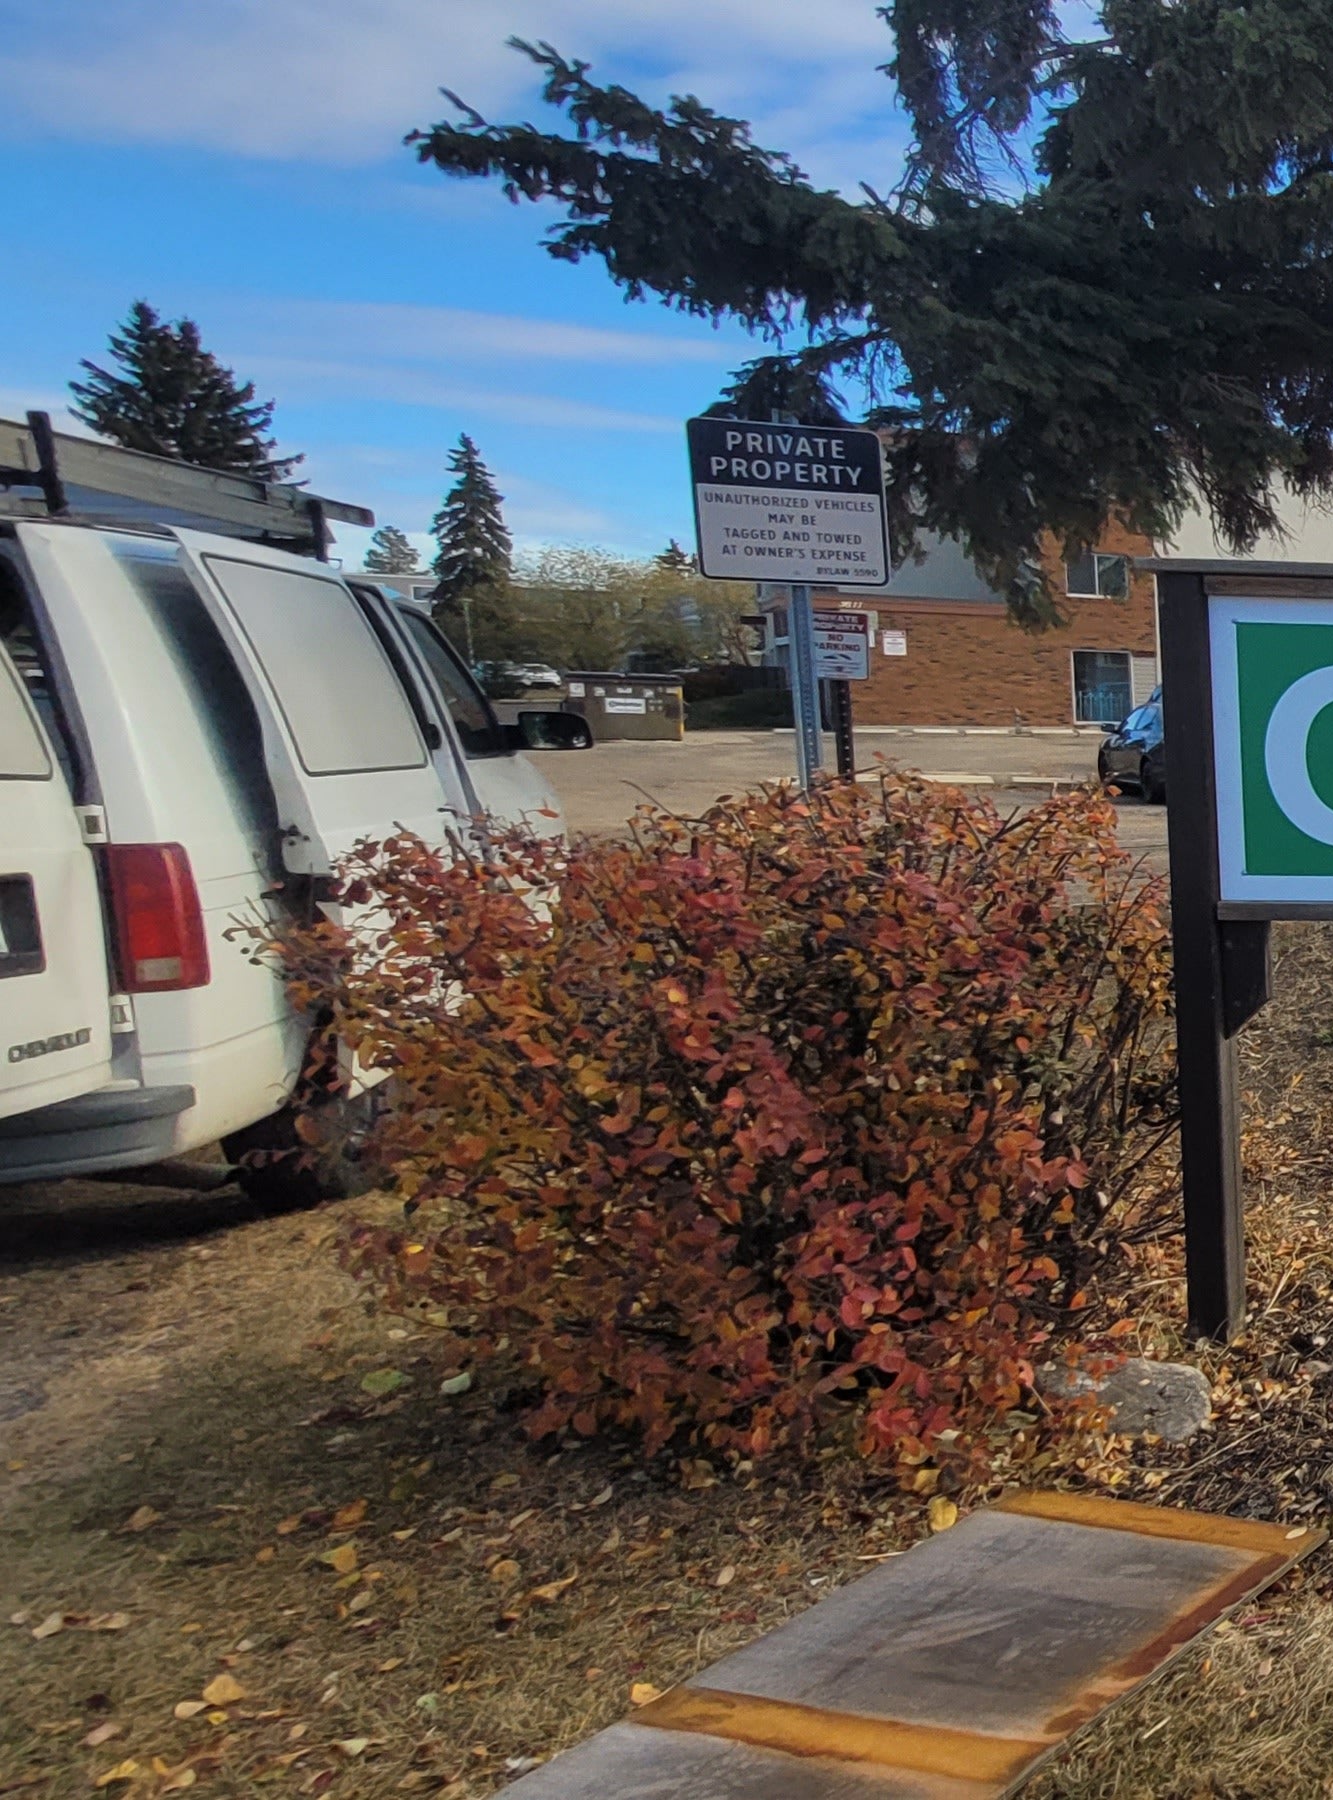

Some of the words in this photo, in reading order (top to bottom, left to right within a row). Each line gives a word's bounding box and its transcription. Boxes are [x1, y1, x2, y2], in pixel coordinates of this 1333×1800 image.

[726, 431, 846, 460] PRIVATE
[710, 456, 862, 486] PROPERTY
[704, 491, 808, 509] UNAUTHORIZED
[815, 500, 875, 513] VEHICLES
[768, 513, 795, 525] MAY
[801, 515, 817, 526] BE
[724, 527, 776, 541] TAGGED
[782, 531, 810, 542] AND
[816, 533, 862, 545] TOWED
[722, 544, 737, 555] AT
[743, 545, 806, 559] OWNER'S
[811, 549, 867, 562] EXPENSE
[817, 567, 849, 576] BYLAW
[812, 621, 864, 631] ROPERTY
[828, 634, 843, 642] NO
